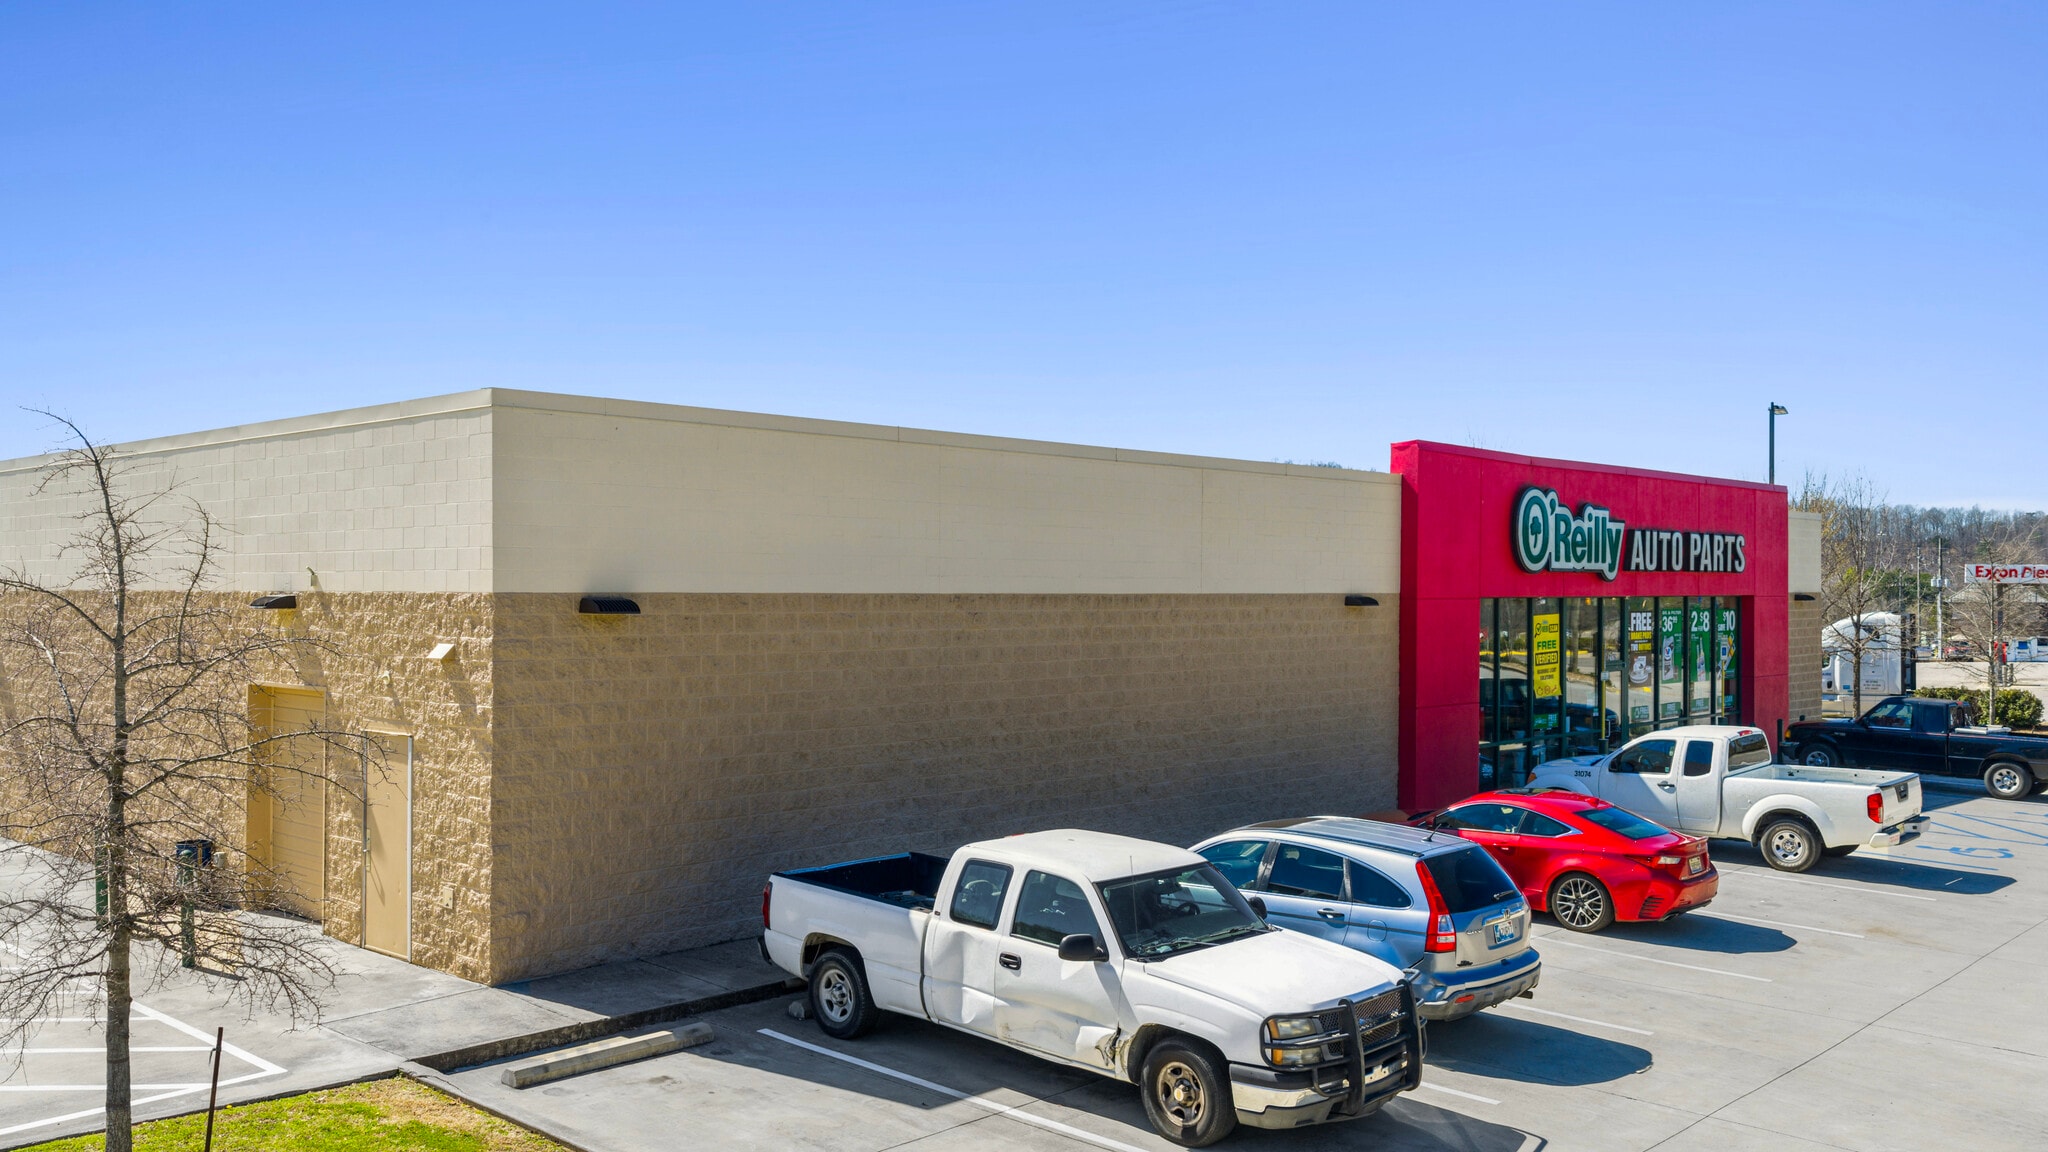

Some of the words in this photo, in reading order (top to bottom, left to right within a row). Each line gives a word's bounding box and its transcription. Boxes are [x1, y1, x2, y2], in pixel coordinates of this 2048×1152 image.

[1521, 495, 1622, 574] O'Reilly
[1630, 530, 1683, 571] AUTO
[1689, 533, 1746, 573] PARTS
[1630, 612, 1652, 632] FREE
[1691, 611, 1698, 631] 2
[1537, 640, 1557, 650] FREE
[1536, 652, 1558, 665] VERIFIED
